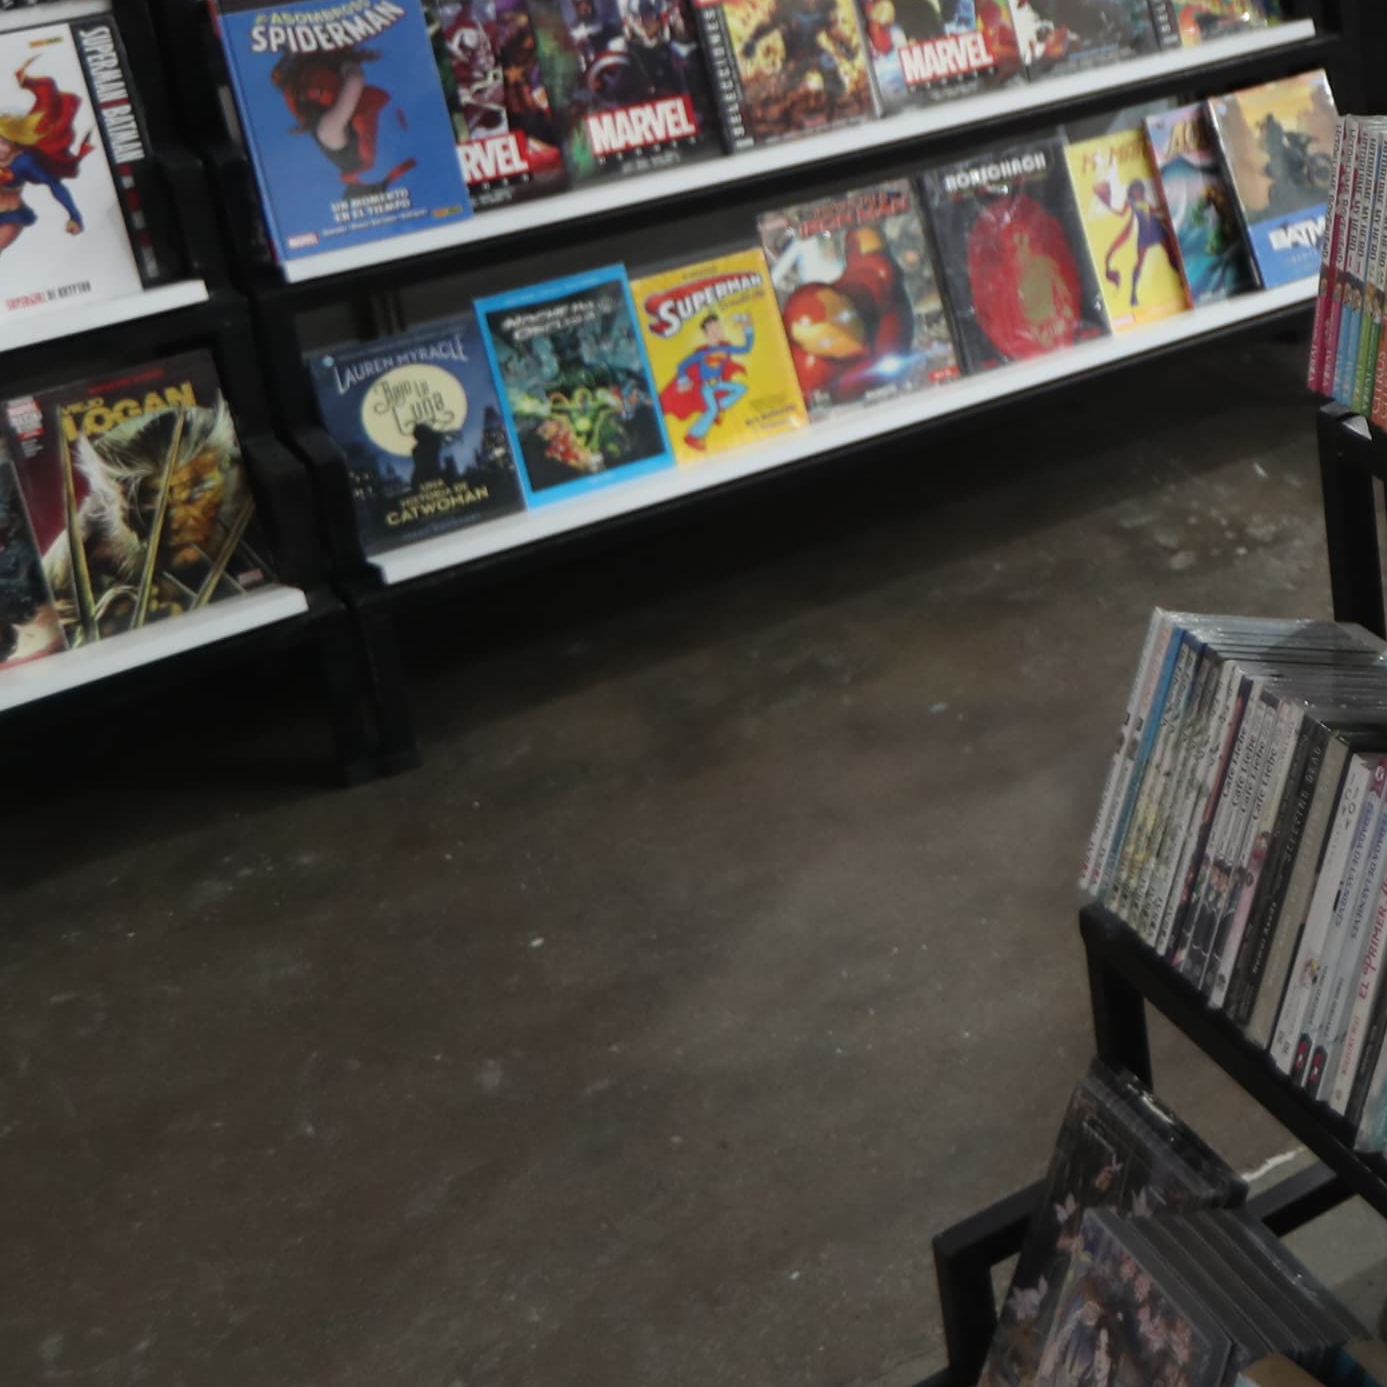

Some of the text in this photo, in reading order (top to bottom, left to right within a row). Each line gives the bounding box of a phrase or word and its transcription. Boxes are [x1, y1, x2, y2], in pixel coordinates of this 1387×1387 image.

[251, 0, 406, 54] SPIDERMAN
[901, 33, 992, 85] MARVEL
[587, 98, 696, 157] MARVEL
[461, 138, 528, 183] RVEL
[1268, 216, 1326, 253] BATM
[654, 272, 763, 338] SUPERMAN
[336, 338, 468, 395] LAUREN MYRACLE
[60, 381, 197, 443] LOGAN
[386, 486, 488, 525] CATWOMAN
